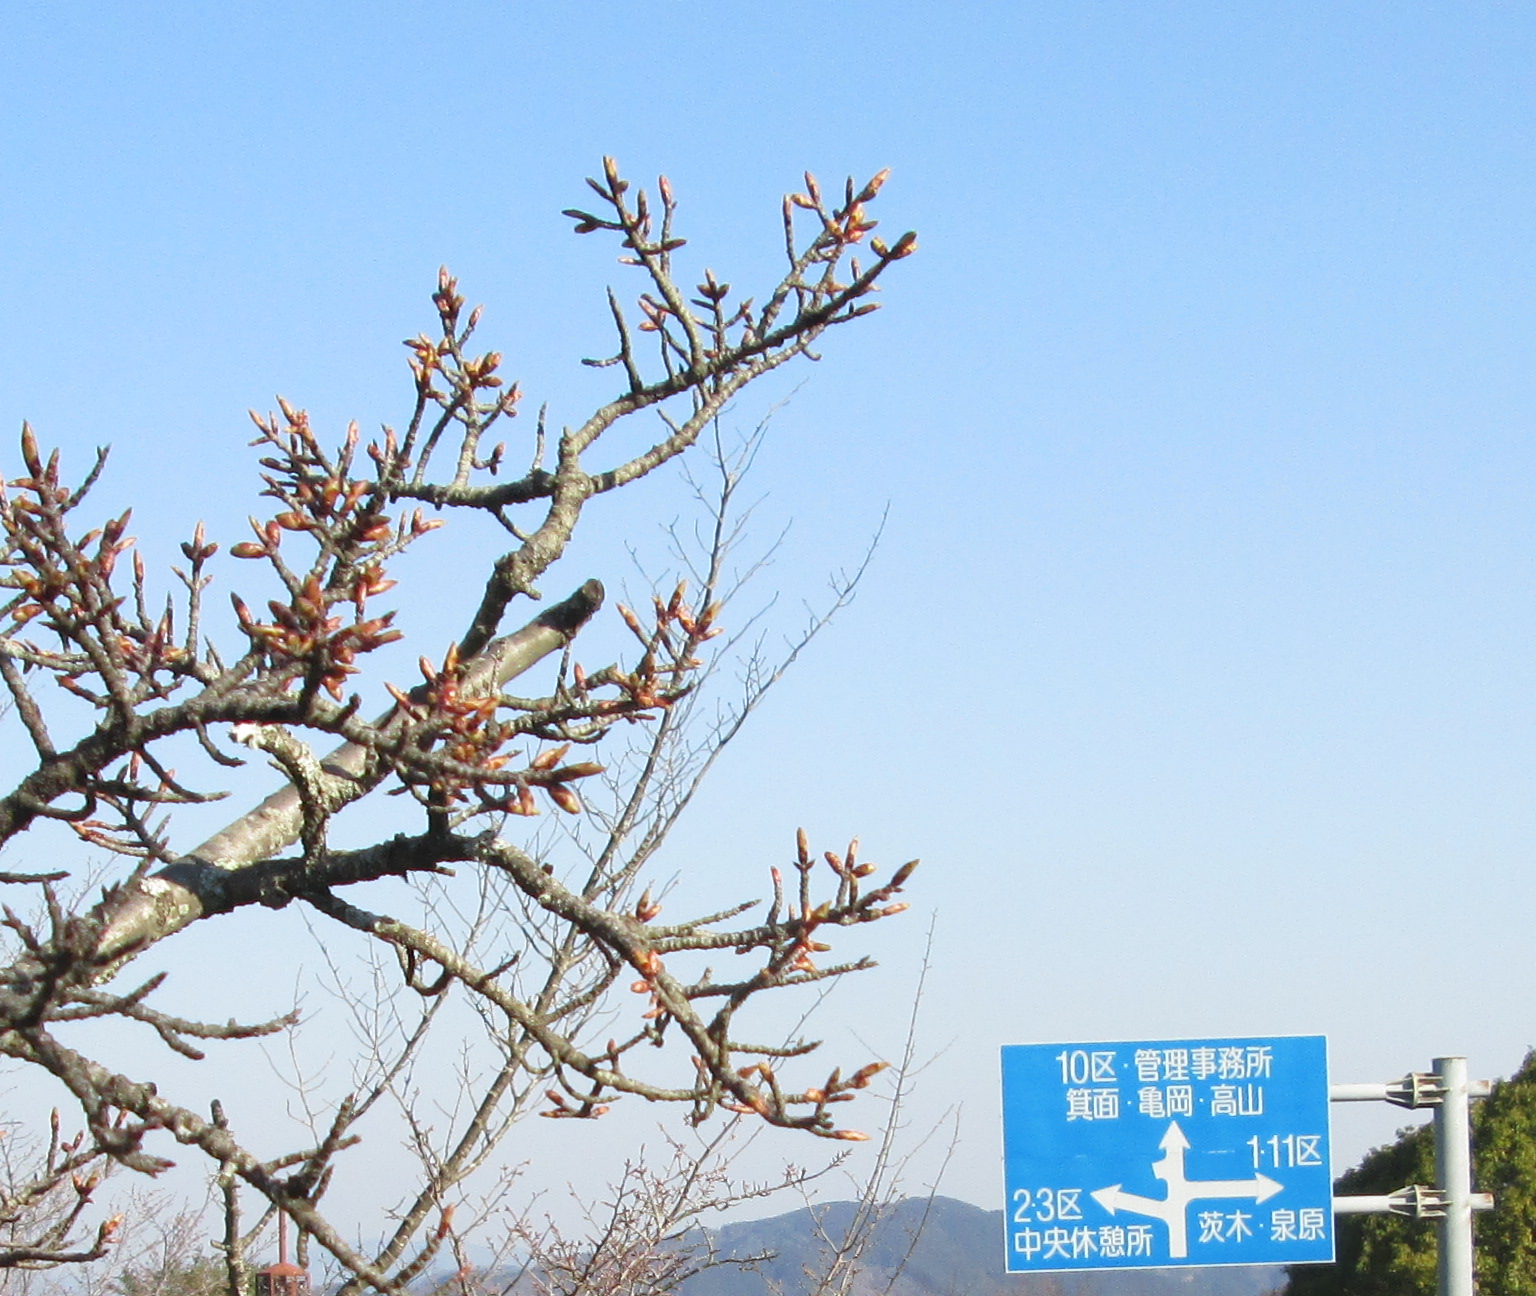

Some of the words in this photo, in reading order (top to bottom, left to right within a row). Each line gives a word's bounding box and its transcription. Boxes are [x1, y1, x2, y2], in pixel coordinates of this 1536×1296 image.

[1014, 1224, 1154, 1260] 中央休憩所
